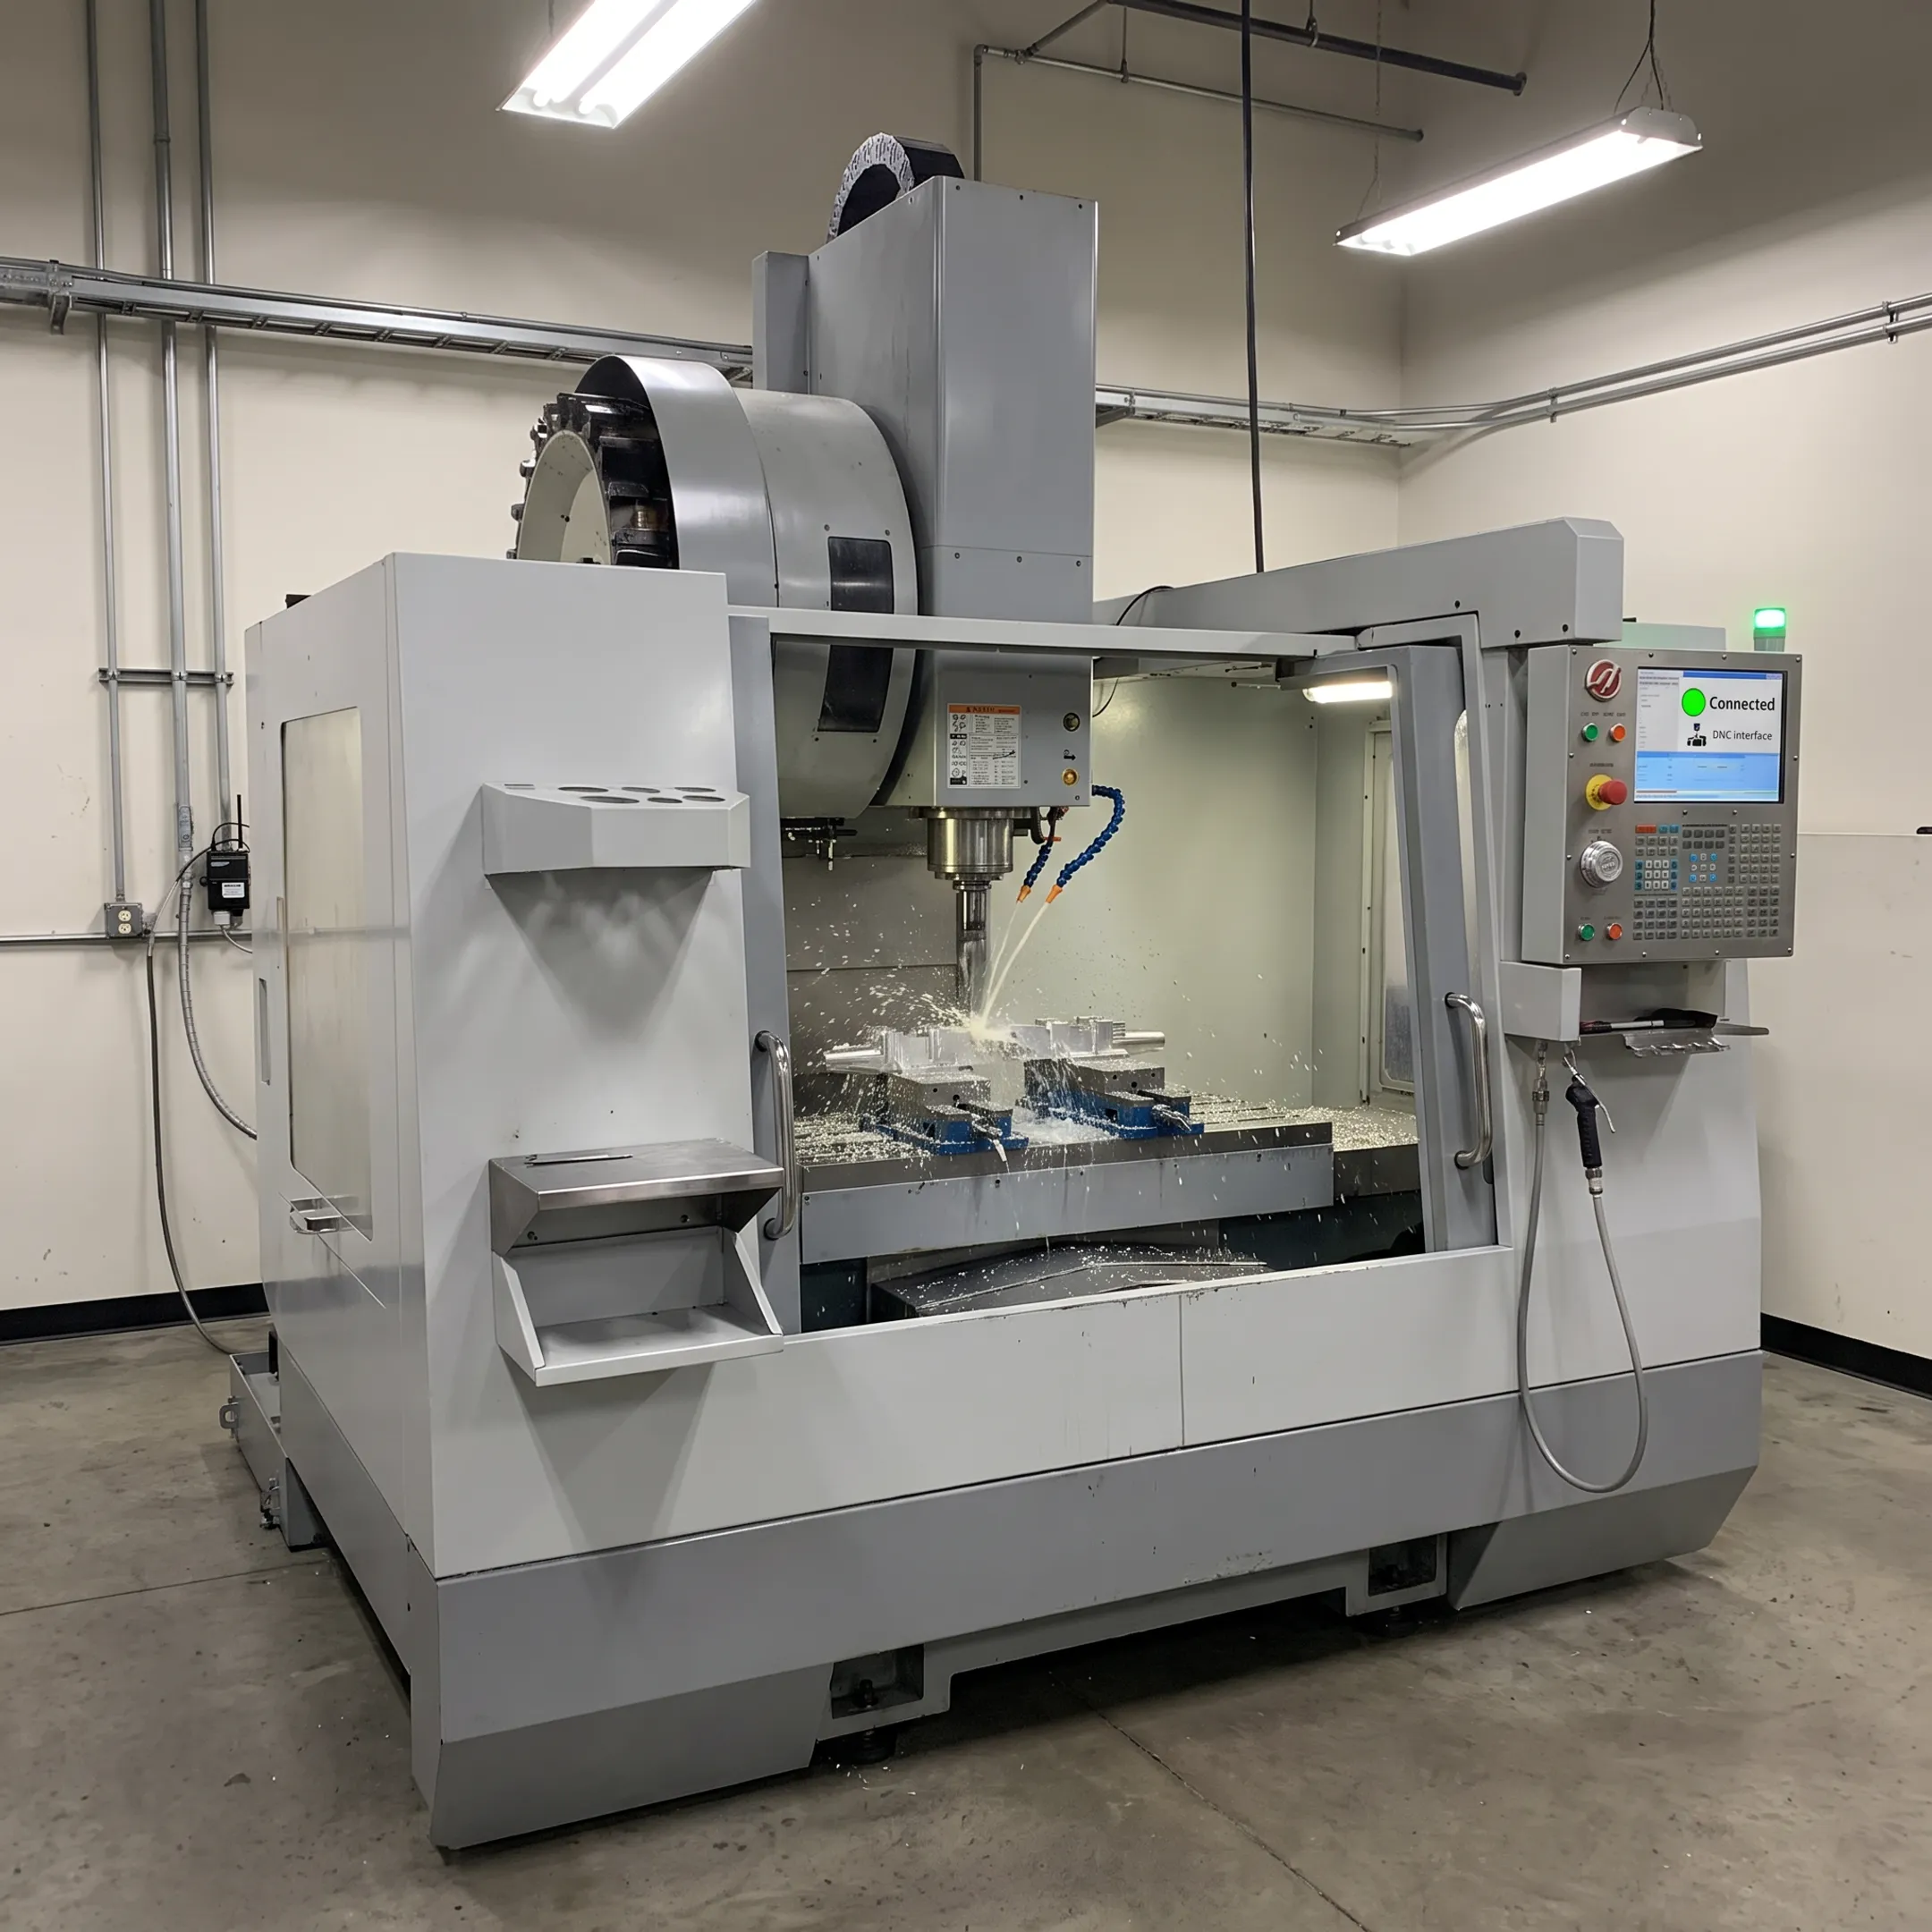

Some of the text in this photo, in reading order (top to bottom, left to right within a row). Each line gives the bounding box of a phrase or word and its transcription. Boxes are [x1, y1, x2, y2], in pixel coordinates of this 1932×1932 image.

[1709, 696, 1775, 711] Connected
[1713, 730, 1773, 741] DNC interface
